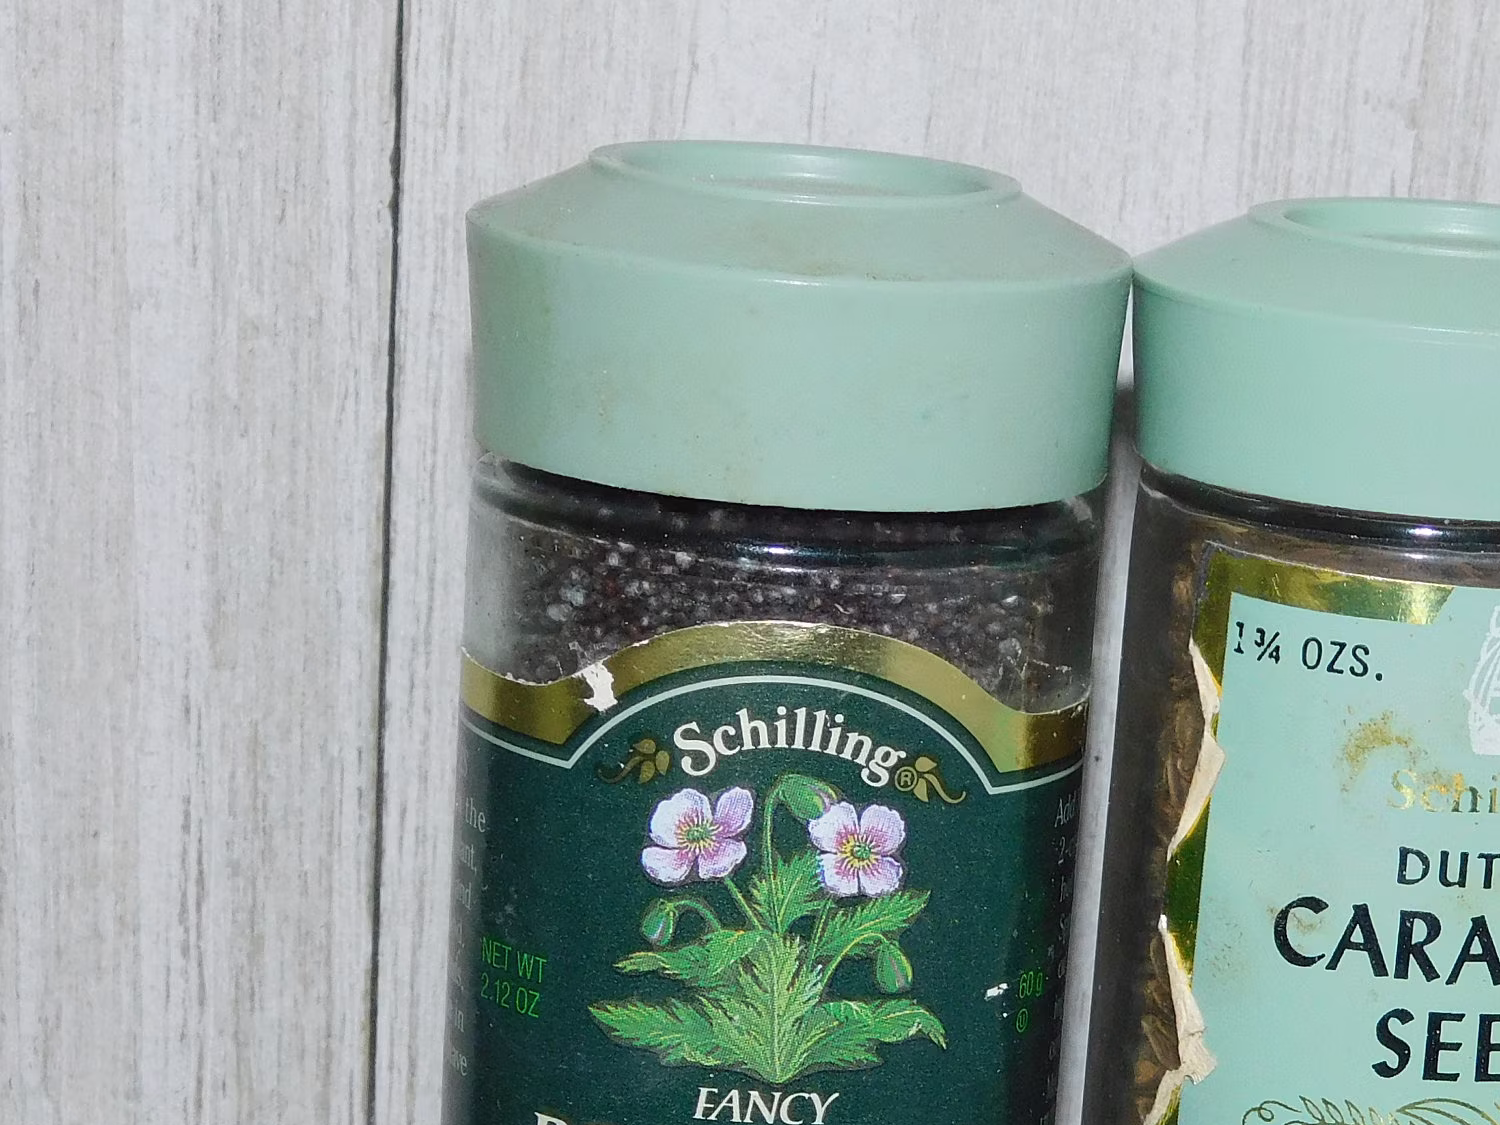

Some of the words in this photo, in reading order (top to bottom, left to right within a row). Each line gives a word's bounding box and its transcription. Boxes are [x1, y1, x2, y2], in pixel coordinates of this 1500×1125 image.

[1301, 636, 1383, 682] OZS.
[482, 936, 512, 971] NET
[516, 951, 547, 983] WT
[480, 972, 511, 1008] 2.12
[516, 987, 540, 1018] OZ
[692, 1087, 839, 1125] FANCY
